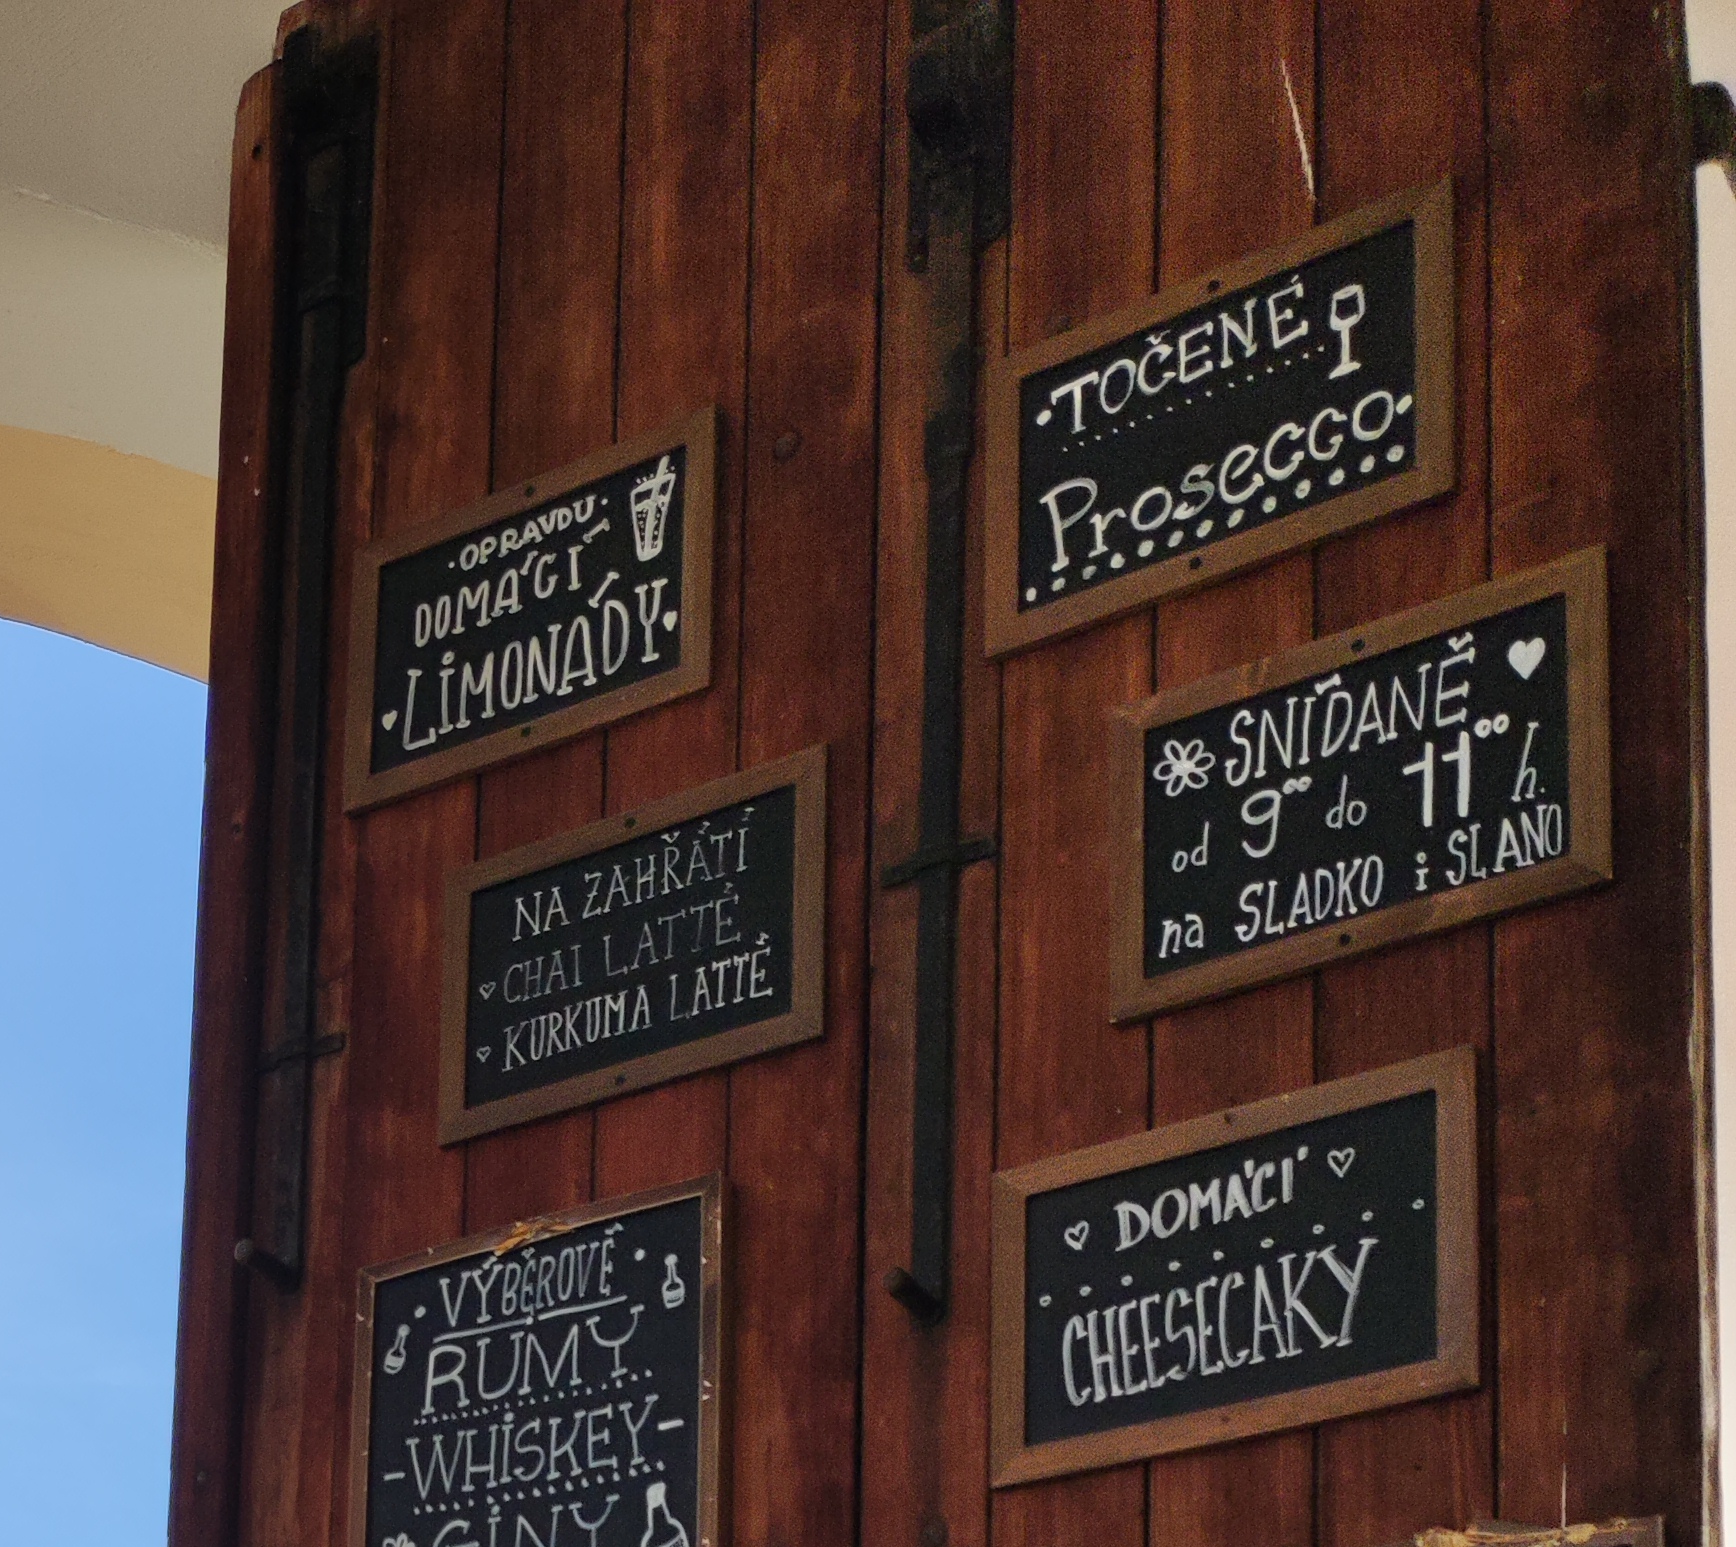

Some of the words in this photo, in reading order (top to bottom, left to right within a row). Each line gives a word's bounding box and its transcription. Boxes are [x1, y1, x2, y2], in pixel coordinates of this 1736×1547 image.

[1050, 274, 1309, 435] TOČENÉ
[414, 518, 611, 648] DOMÁCÍ
[459, 495, 596, 571] OPRAVDU
[1171, 820, 1210, 873] od
[1325, 774, 1367, 829] do
[511, 886, 571, 943] NA
[1157, 912, 1205, 959] na
[1234, 853, 1384, 944] SLADKO
[1414, 851, 1430, 891] i
[502, 944, 584, 1005] CHAI
[500, 983, 653, 1073] KURKUMA
[420, 1304, 645, 1416] RUMY
[1061, 1237, 1381, 1407] CHEESECAKY
